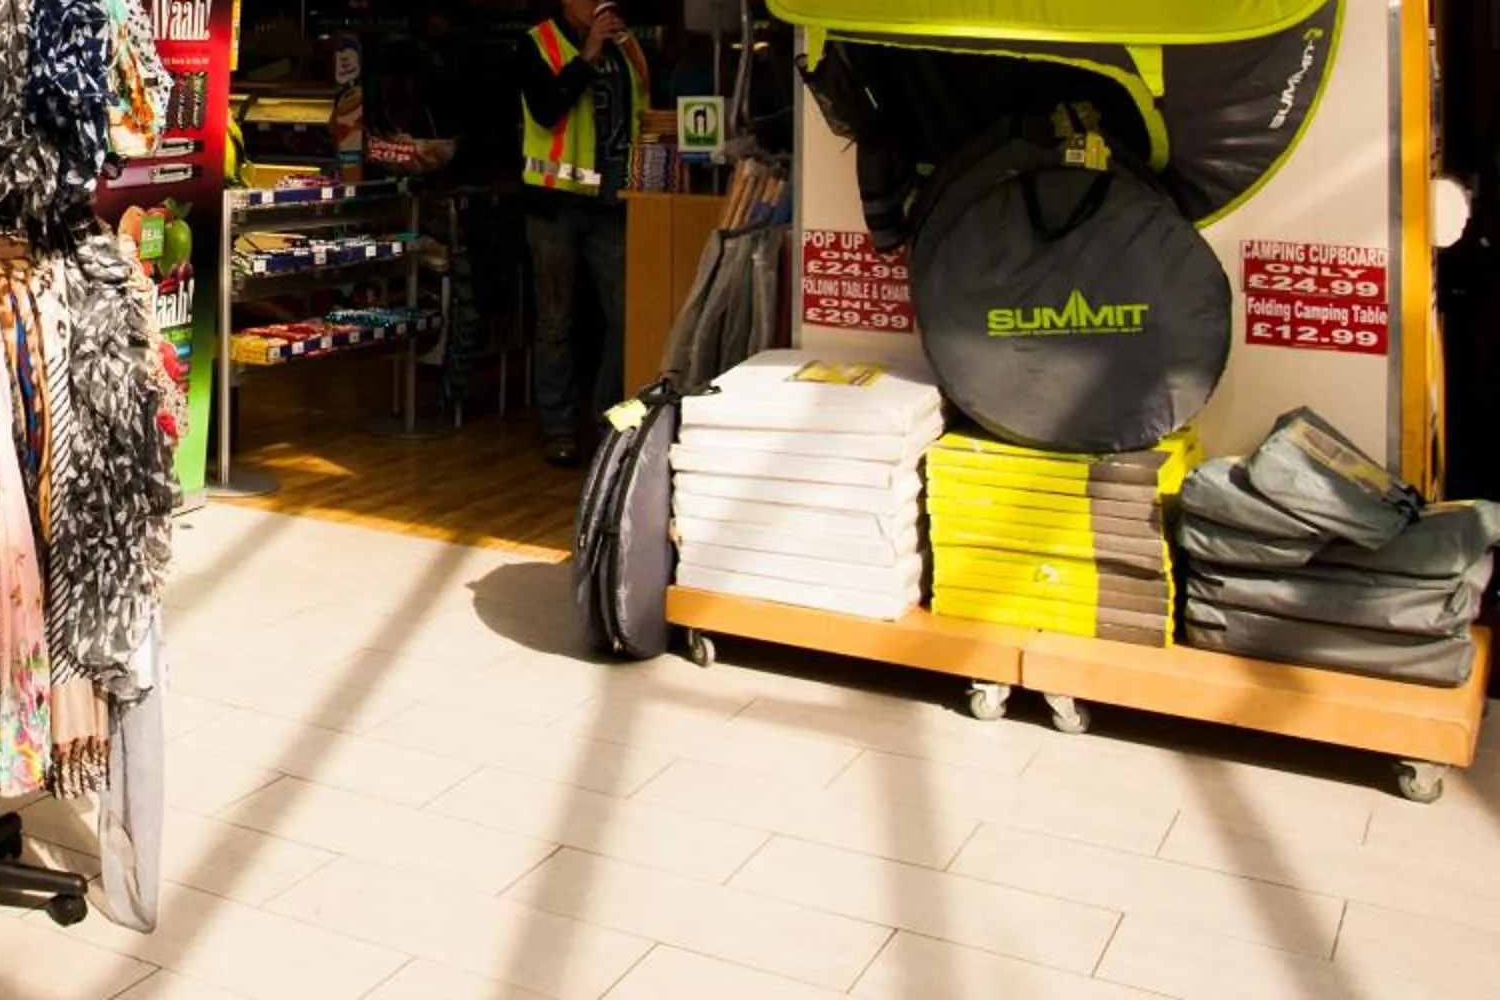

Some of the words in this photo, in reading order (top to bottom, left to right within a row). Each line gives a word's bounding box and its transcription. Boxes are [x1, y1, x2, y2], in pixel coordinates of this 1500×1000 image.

[803, 231, 836, 249] POP
[841, 232, 864, 250] UP
[820, 250, 899, 263] ONLY
[1241, 241, 1305, 262] CAMPING
[1309, 245, 1388, 268] CUPBOARD
[806, 260, 909, 279] £24.99
[1264, 263, 1367, 278] ONLY
[1249, 274, 1379, 297] £24.99
[820, 298, 899, 312] ONLY
[987, 288, 1150, 330] SUMMIT
[1247, 297, 1291, 321] Folding
[1294, 301, 1349, 326] Camping
[1351, 305, 1388, 325] Table
[806, 307, 909, 329] £29.99
[1252, 322, 1379, 347] £12.99
